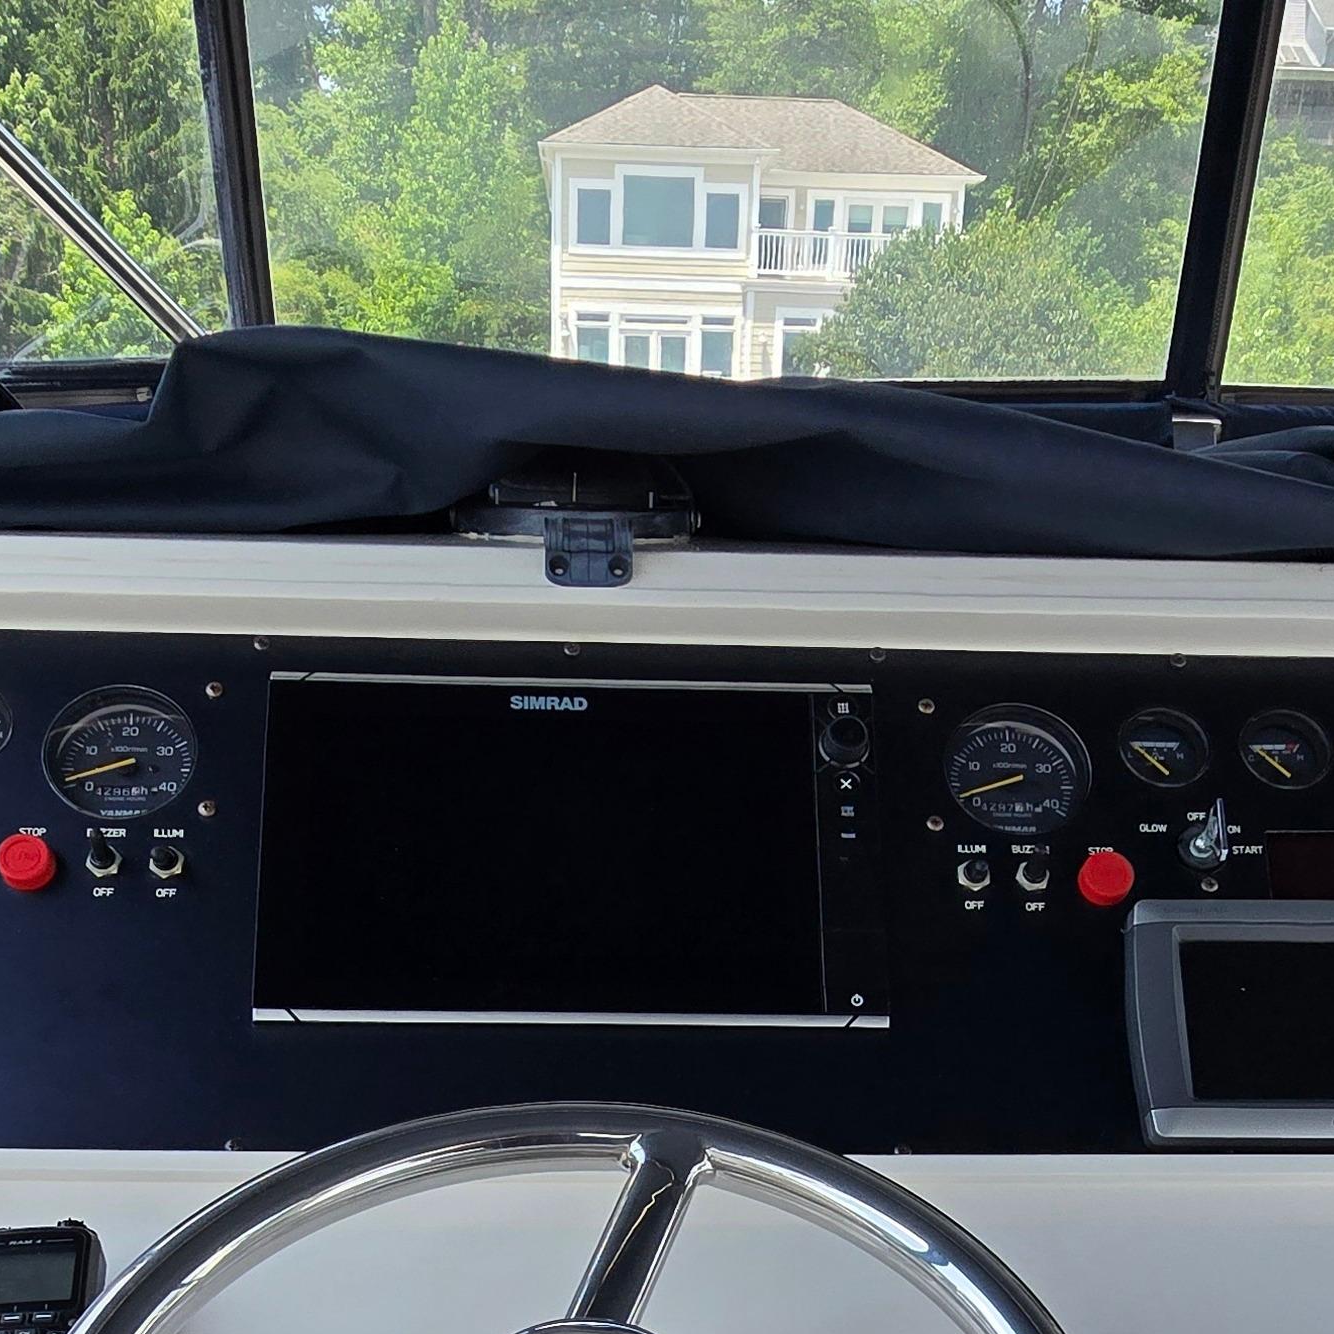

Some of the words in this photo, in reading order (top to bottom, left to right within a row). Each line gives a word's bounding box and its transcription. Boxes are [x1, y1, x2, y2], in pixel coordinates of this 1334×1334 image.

[510, 695, 588, 711] SIMRAD
[122, 726, 139, 736] 20
[85, 746, 98, 755] 10
[156, 746, 174, 756] 30
[1000, 743, 1017, 753] 20
[968, 761, 980, 771] 10
[1035, 763, 1052, 774] 30
[84, 782, 94, 791] 0
[158, 781, 177, 792] 40
[972, 797, 981, 807] 0
[1043, 799, 1059, 810] 40
[1187, 812, 1206, 821] OFF
[18, 827, 47, 837] STOP
[153, 828, 185, 838] ILLUMI
[1139, 824, 1168, 833] GLOW
[1227, 825, 1242, 834] ON
[957, 844, 987, 854] ILLUMI
[1232, 845, 1264, 855] START
[93, 887, 115, 897] OFF
[155, 888, 177, 898] OFF
[964, 900, 985, 910] OFF
[1025, 902, 1046, 912] OFF
